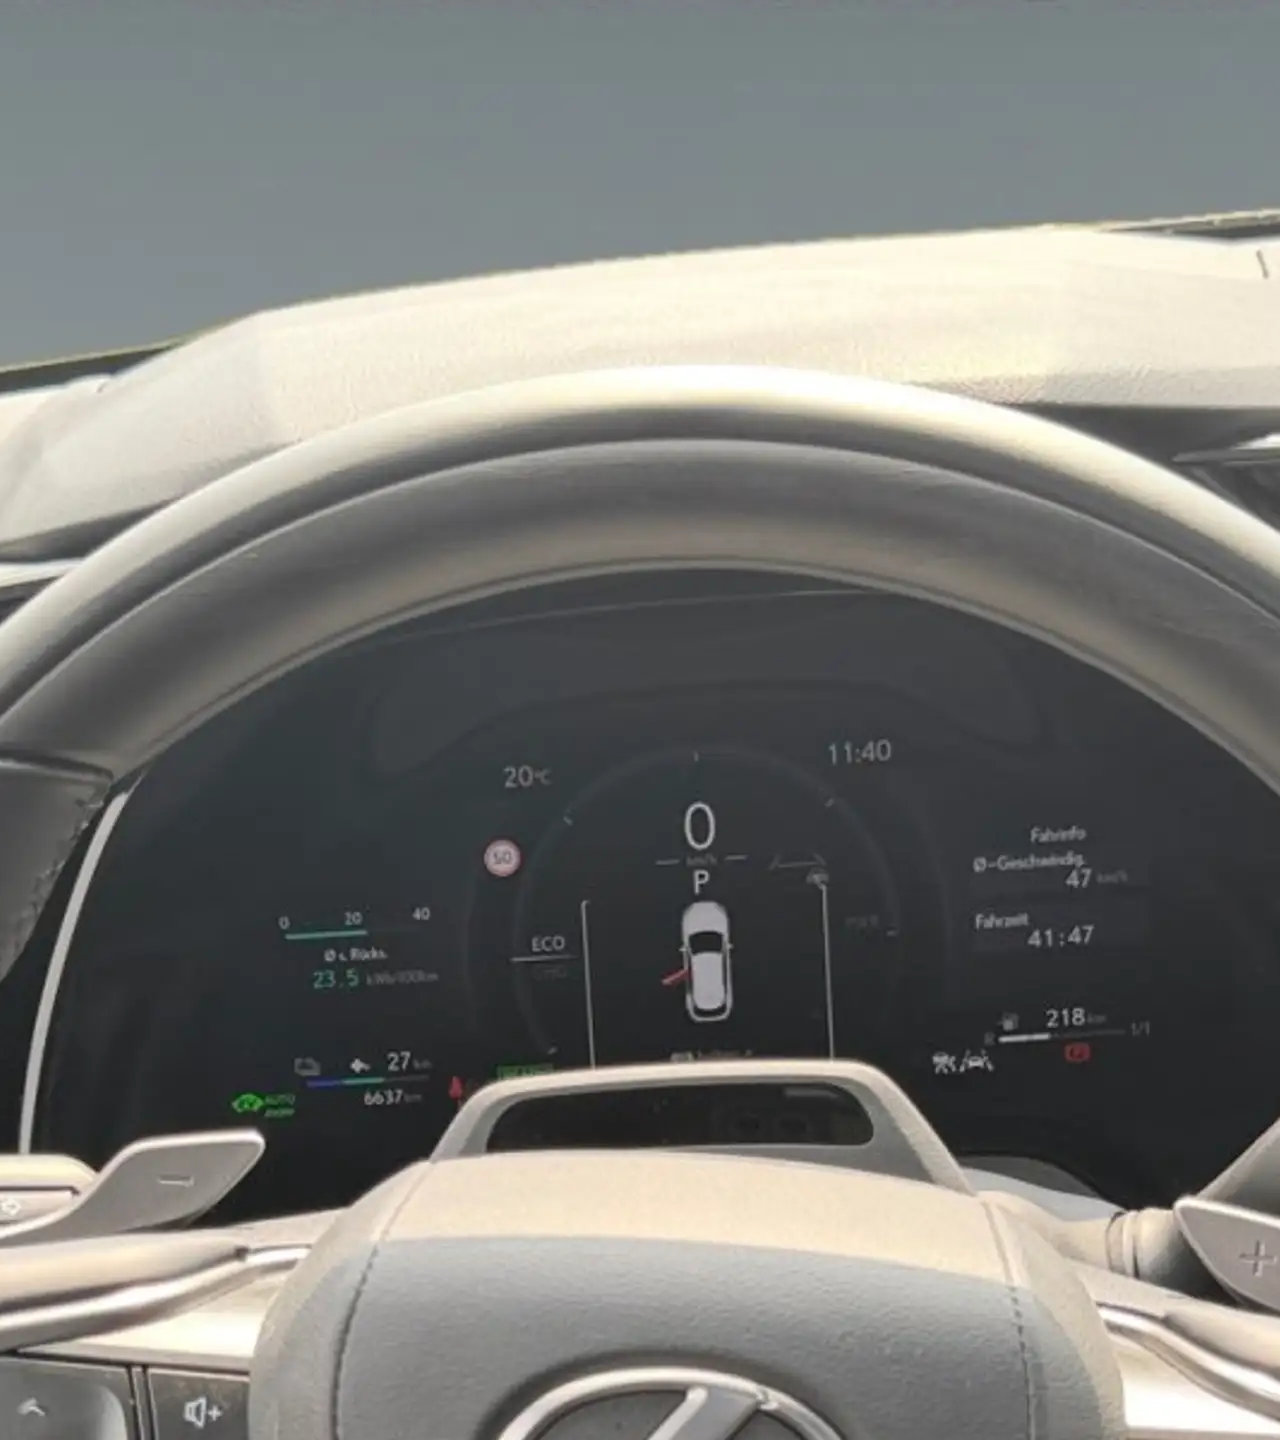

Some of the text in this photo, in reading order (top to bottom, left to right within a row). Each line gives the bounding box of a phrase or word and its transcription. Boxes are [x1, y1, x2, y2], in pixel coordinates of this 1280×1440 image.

[827, 738, 893, 766] 11:40
[683, 800, 716, 851] 0
[1030, 825, 1087, 843] Fahrinfo
[693, 869, 710, 895] P
[1065, 868, 1092, 889] 47
[278, 905, 431, 931] 0 20 40
[975, 912, 1029, 931] Fahrzeit
[531, 935, 566, 953] ECO
[1028, 924, 1095, 948] 41:47
[312, 968, 360, 990] 23.5
[1046, 1007, 1086, 1028] 218
[387, 1051, 411, 1073] 27
[363, 1087, 404, 1107] 6637
